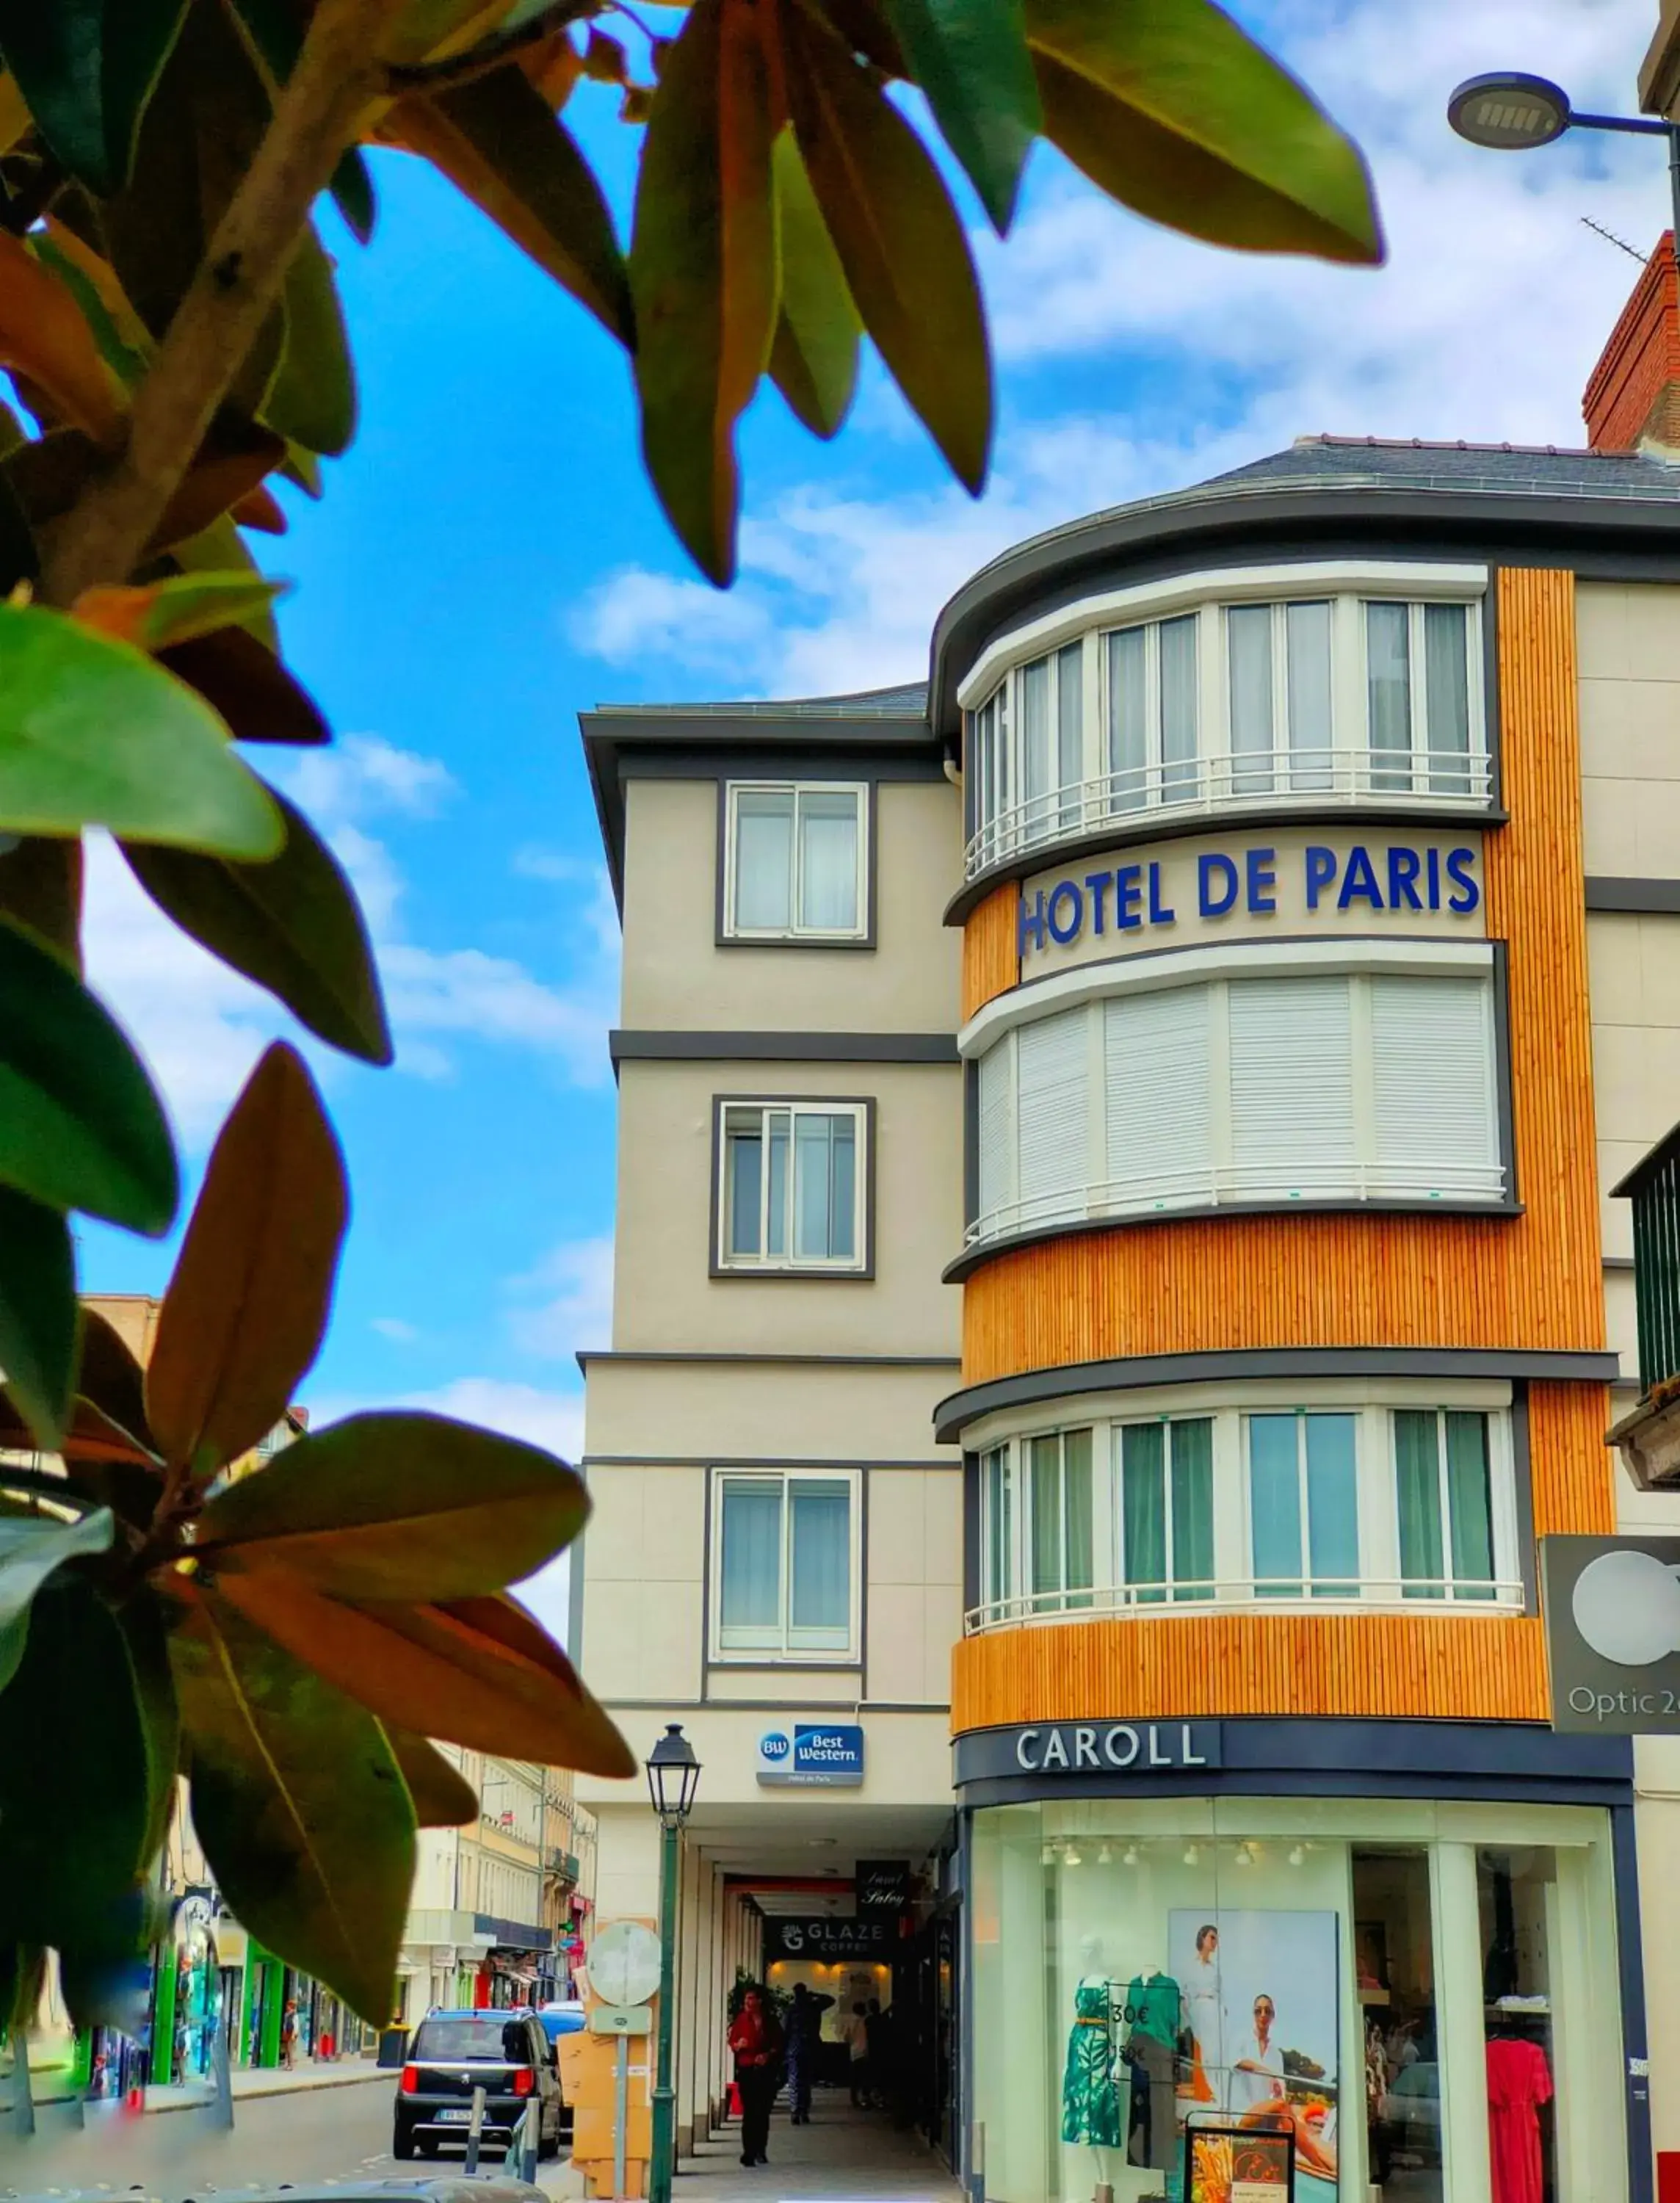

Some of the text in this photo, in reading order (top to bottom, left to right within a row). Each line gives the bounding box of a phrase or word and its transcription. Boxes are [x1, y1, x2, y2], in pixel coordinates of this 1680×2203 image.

[1018, 846, 1480, 957] HOTEL DE PARIS
[1568, 1687, 1680, 1722] Optic 2
[764, 1740, 786, 1754] BW
[813, 1735, 844, 1748] Best
[1017, 1724, 1206, 1770] CAROLL
[798, 1748, 855, 1761] Western
[808, 1923, 884, 1940] GLAZE
[1111, 2004, 1150, 2025] 30€
